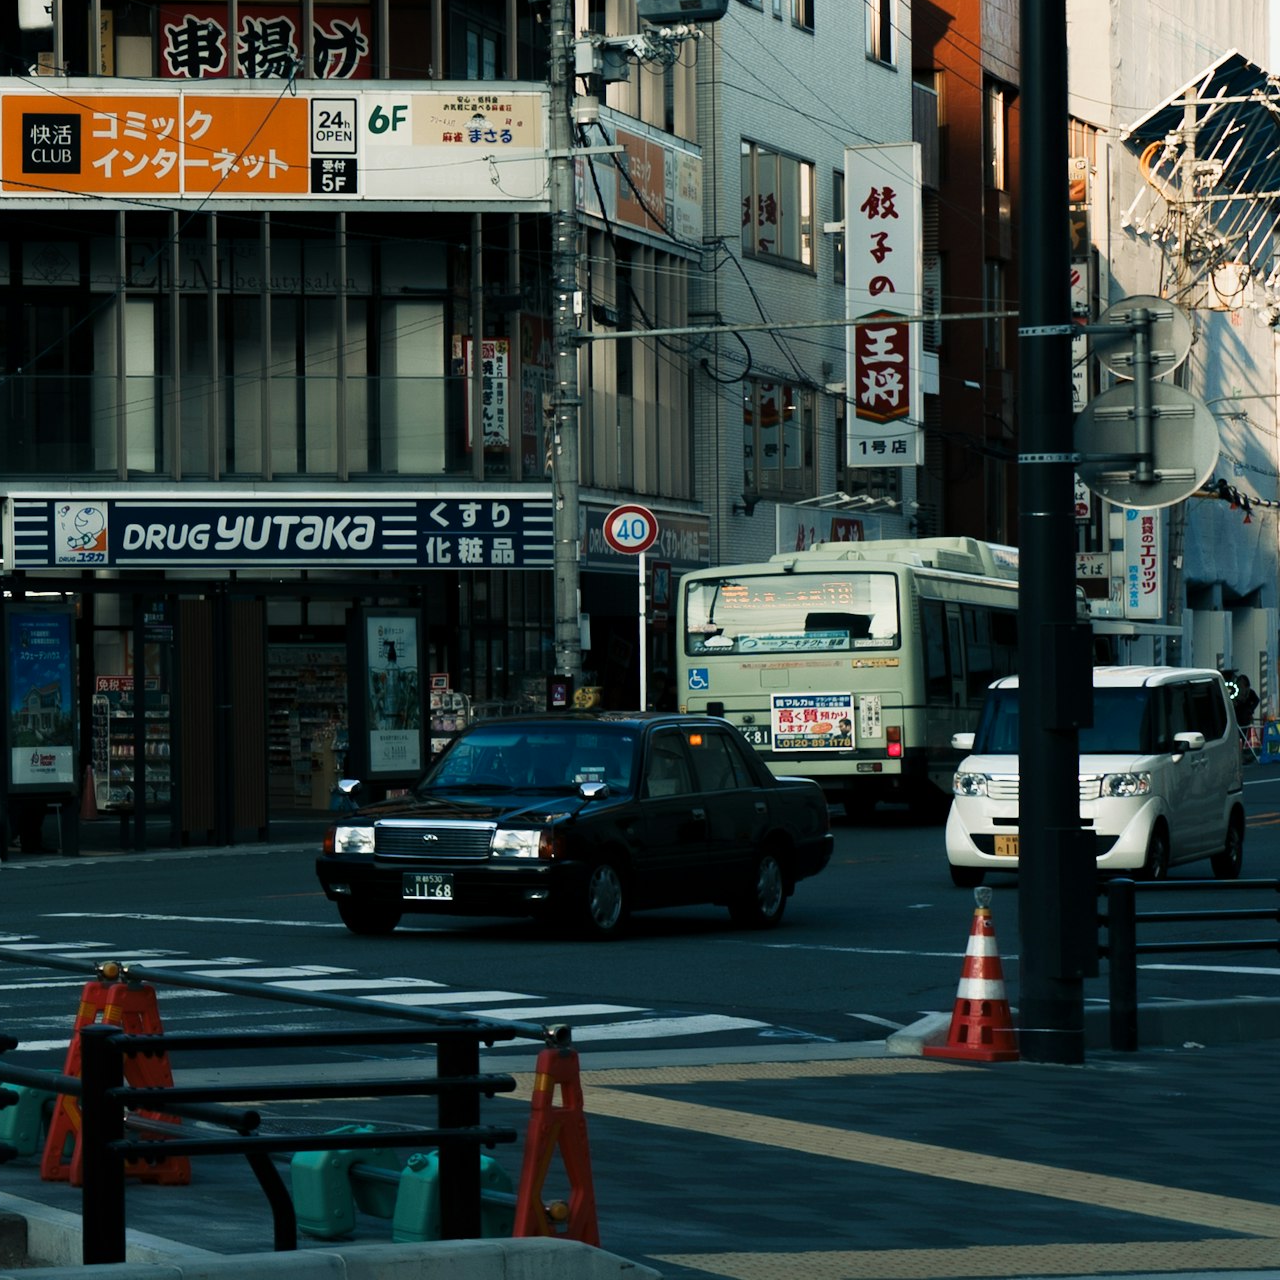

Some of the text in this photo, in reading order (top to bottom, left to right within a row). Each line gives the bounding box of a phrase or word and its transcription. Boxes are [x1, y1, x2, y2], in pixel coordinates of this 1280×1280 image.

[92, 110, 213, 142] コミック
[318, 110, 352, 130] 24h
[367, 104, 408, 135] 6F
[30, 124, 72, 146] 快活
[315, 130, 353, 143] OPEN
[442, 128, 514, 144] 麻雀 まさる
[31, 148, 72, 164] CLUB
[91, 148, 290, 181] インターネット
[321, 160, 346, 173] 受付
[321, 174, 346, 192] 5F
[860, 186, 904, 408] 餃子の 王将
[858, 439, 909, 456] 1号店
[428, 501, 511, 529] くすり
[122, 522, 212, 552] DRUG
[616, 519, 647, 541] 40
[425, 536, 517, 566] 化粧品
[1077, 562, 1105, 576] そば
[98, 679, 120, 692] 免税
[416, 883, 452, 898] 11-68
